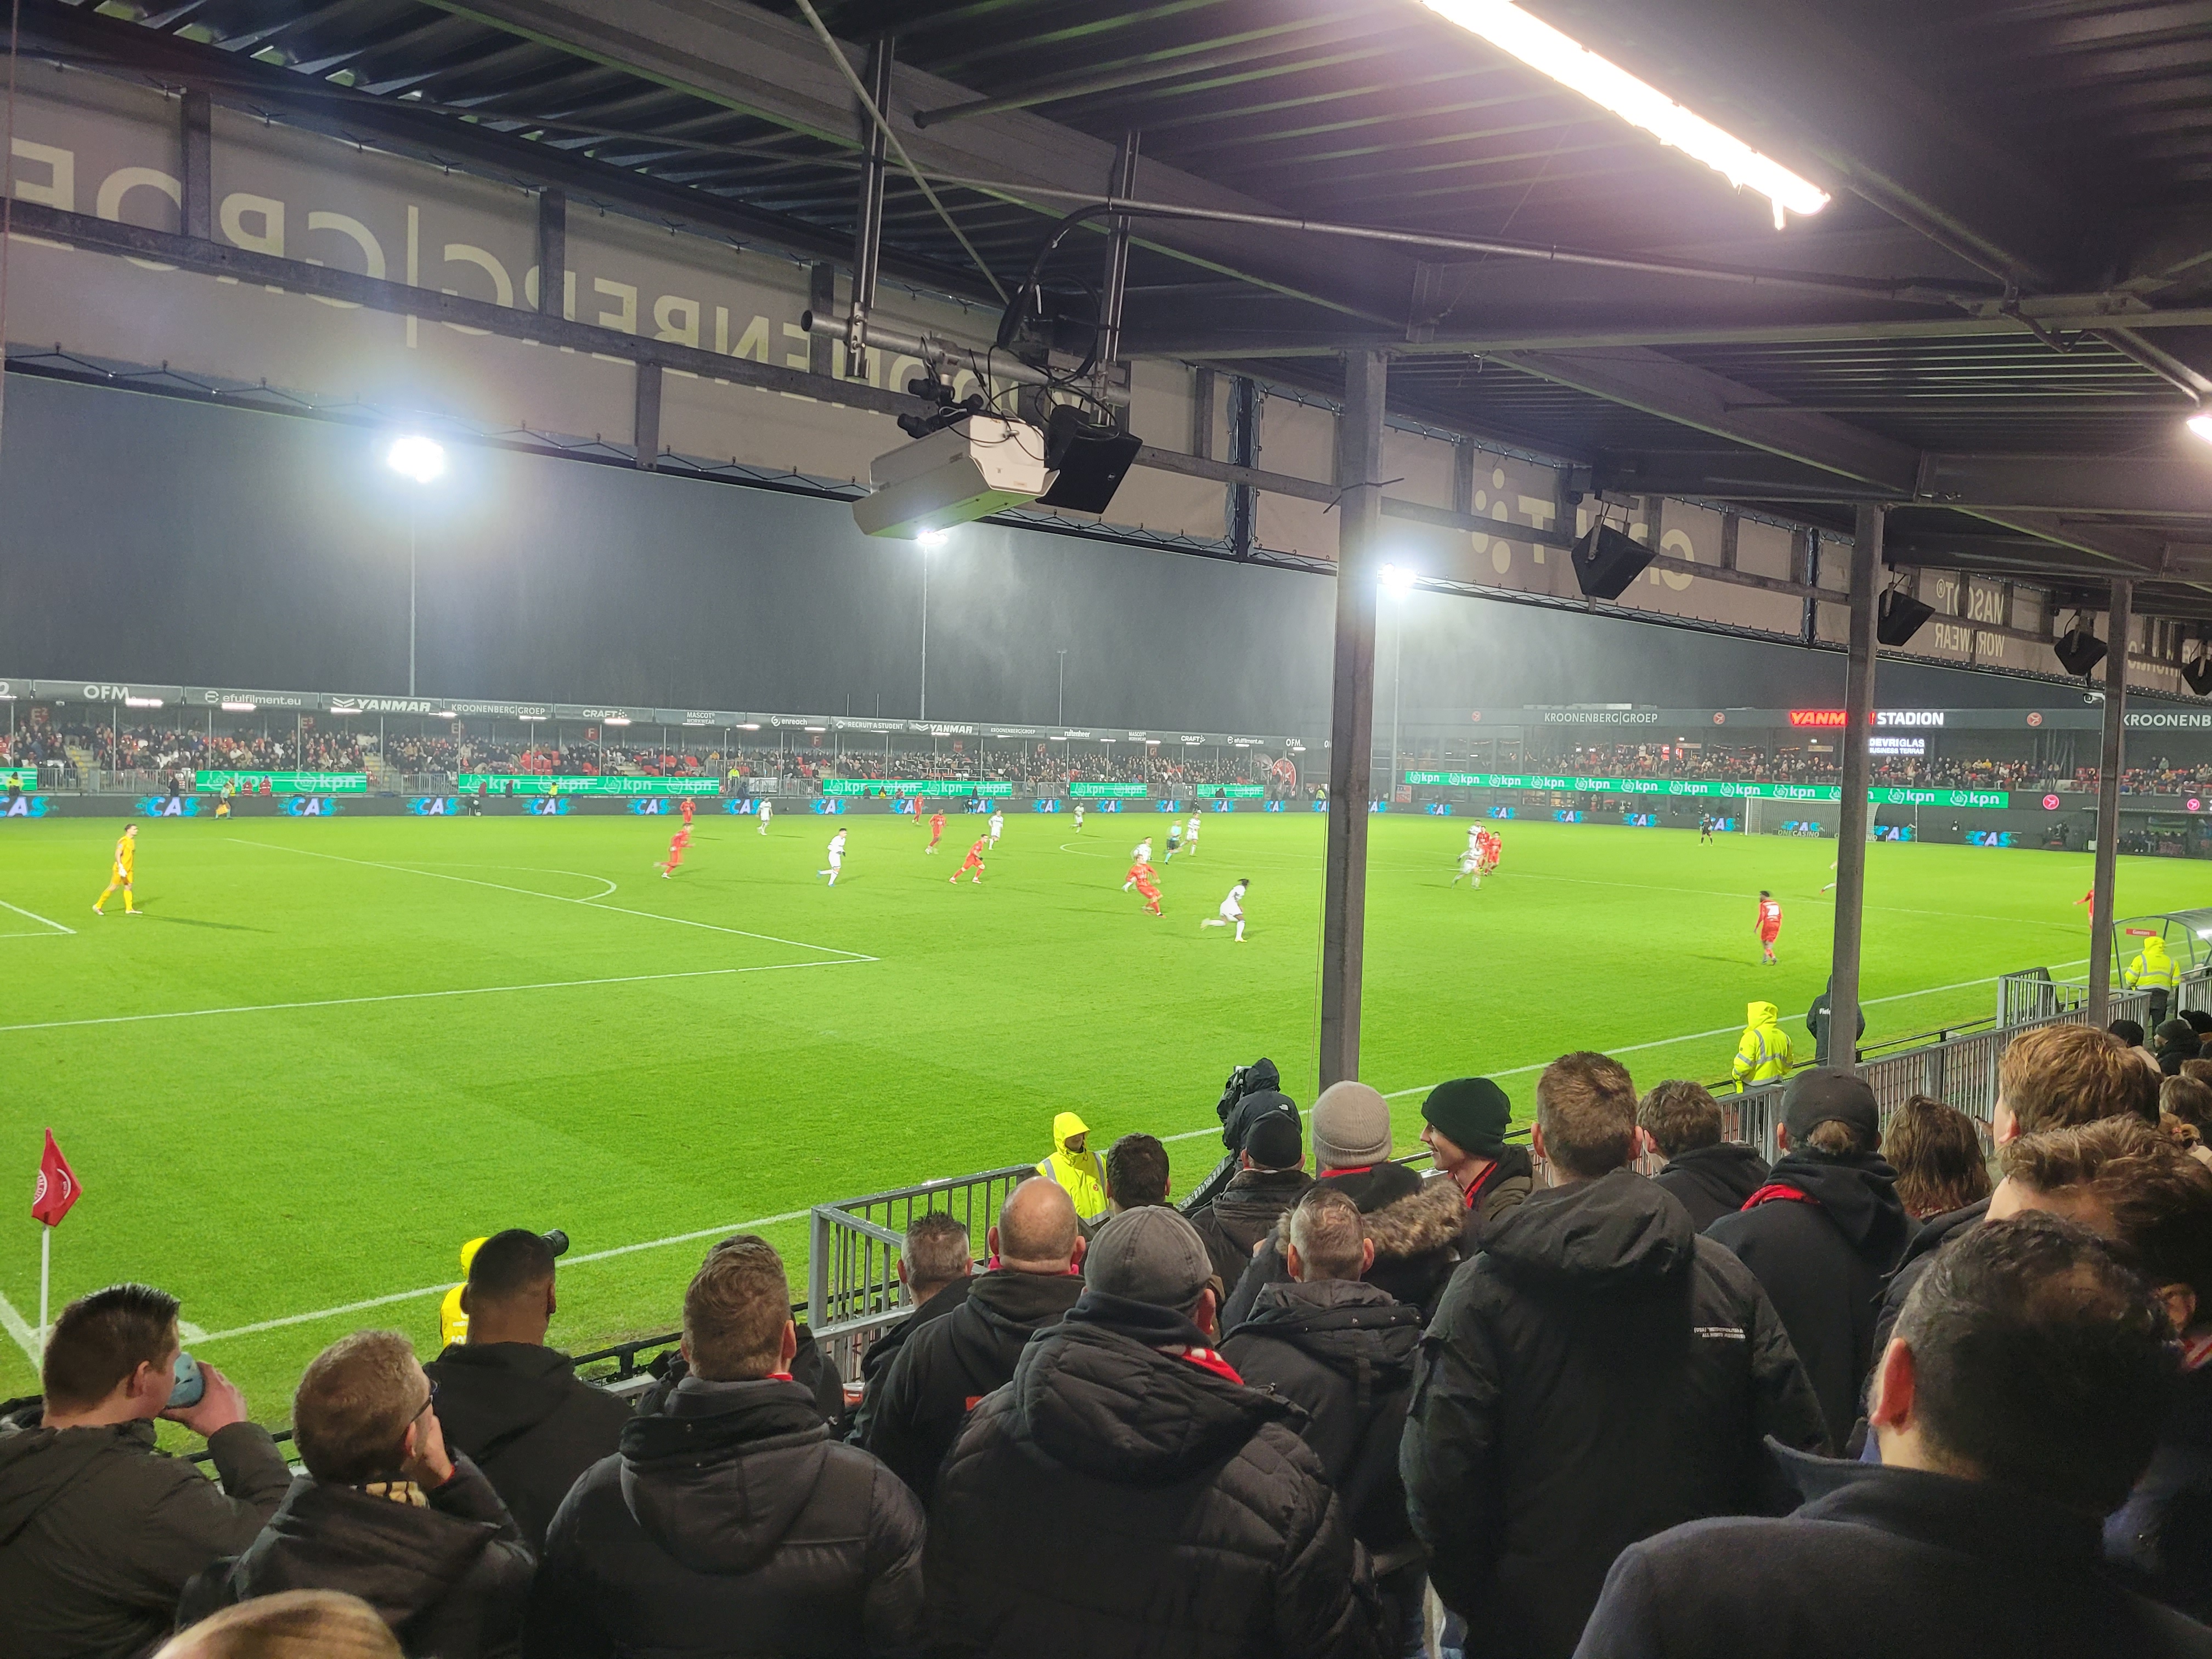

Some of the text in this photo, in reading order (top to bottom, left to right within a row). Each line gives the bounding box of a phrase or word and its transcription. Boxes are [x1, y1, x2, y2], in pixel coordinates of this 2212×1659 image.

[223, 693, 301, 706] efulfilment.eu
[357, 699, 431, 712] YANMAR
[583, 709, 617, 718] CRAFT
[1791, 711, 1944, 725] YANM STADION
[588, 729, 595, 737] F
[930, 724, 973, 733] YANMAR
[1064, 729, 1090, 737] ruitenheer
[814, 736, 819, 745] F
[234, 772, 356, 791] kp kpn
[559, 777, 588, 792] kpn
[623, 777, 651, 793] kpn
[685, 778, 712, 793] kpn
[941, 781, 962, 795] kpn
[986, 782, 1007, 795] kpn
[1421, 772, 1815, 798] kpn kpn kpn kpn kpn kpn kpn kpn kpn
[1086, 783, 1142, 797] kpn kpn
[1245, 786, 1260, 797] kpn
[1906, 789, 2000, 807] kpn kpn
[146, 797, 199, 816] CAS
[288, 797, 336, 816] CAS
[415, 797, 459, 815] CAS
[531, 798, 569, 815] CAS
[634, 798, 671, 815] CAS
[729, 799, 762, 815] CAS
[815, 799, 846, 815] CAS
[895, 799, 915, 814] CA
[1037, 799, 1061, 813] CAS
[1100, 800, 1124, 813] CAS
[1159, 800, 1180, 813] CAS
[1215, 800, 1234, 812] CAS
[1266, 800, 1285, 812] CAS
[1369, 802, 1387, 812] AS
[1428, 804, 1452, 816] CAS
[1491, 806, 1515, 819] CAS
[1557, 810, 1583, 823] CAS
[1628, 813, 1656, 827] CAS
[1972, 831, 2011, 847] CAS
